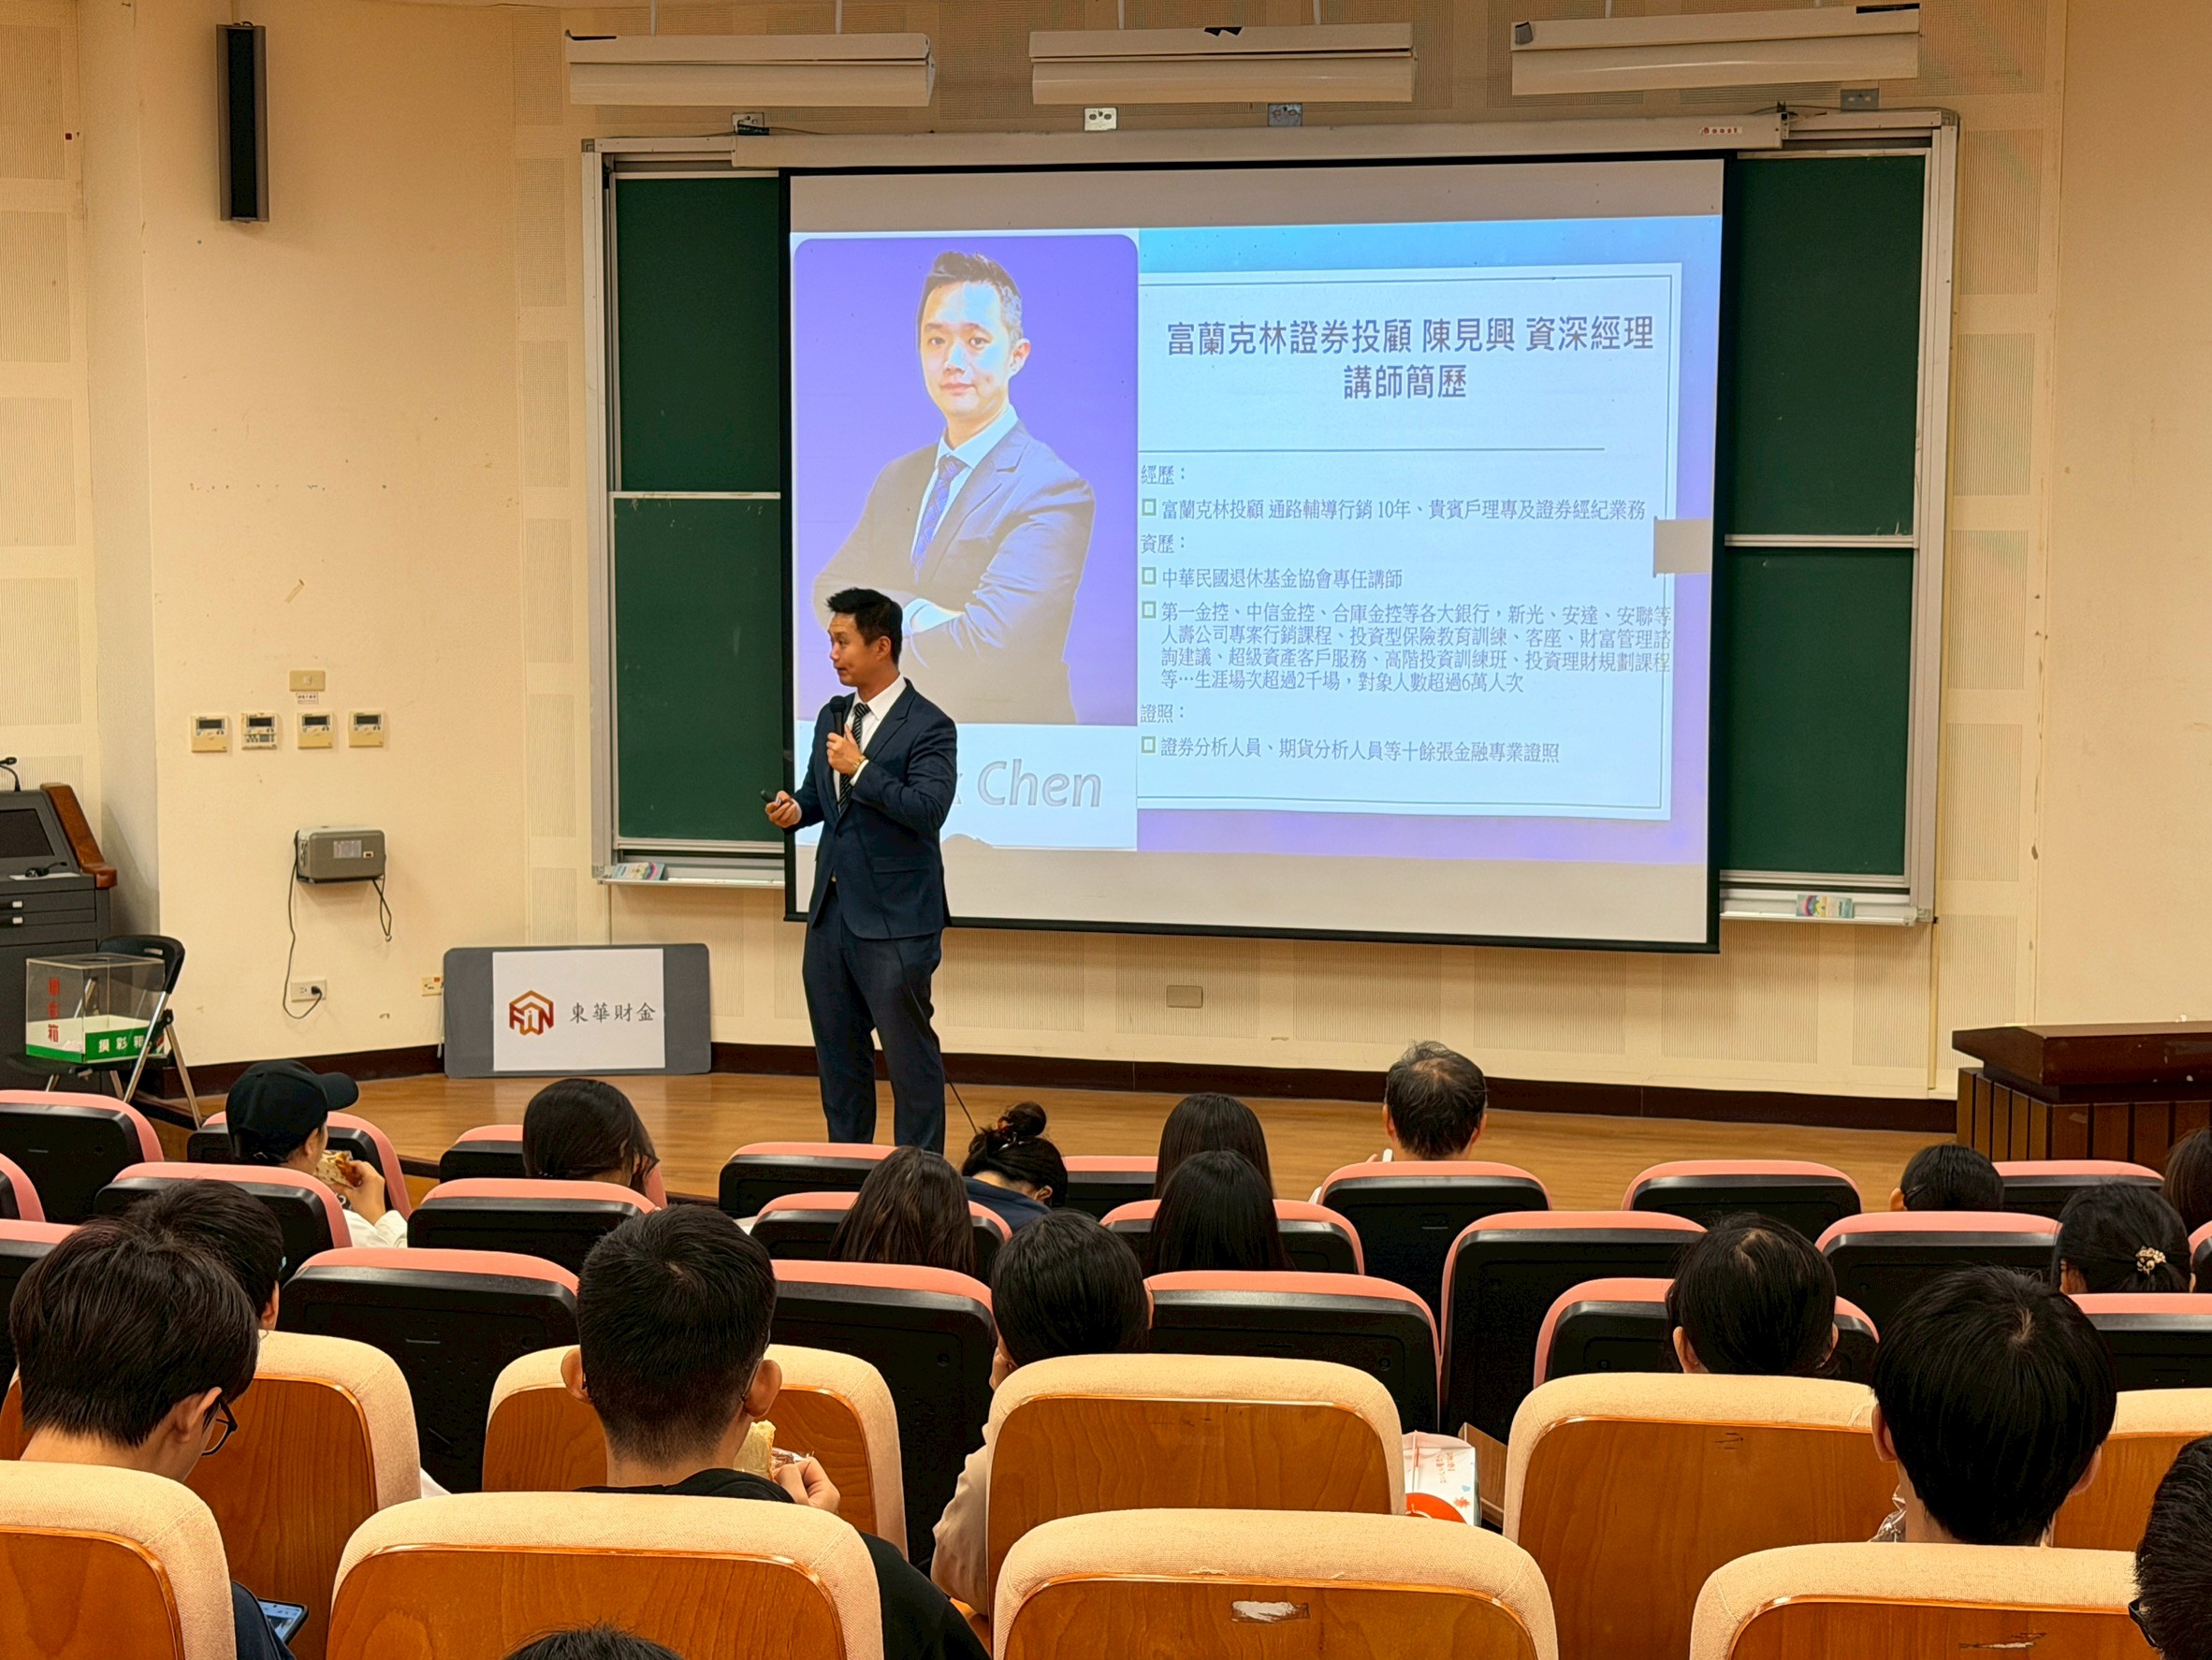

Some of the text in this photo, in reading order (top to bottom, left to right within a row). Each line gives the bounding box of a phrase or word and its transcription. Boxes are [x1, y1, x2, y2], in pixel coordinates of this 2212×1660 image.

[1167, 315, 1653, 357] 富蘭克林證券投顧 陳見興 資深經理
[1344, 364, 1467, 400] 講師簡歷
[1162, 499, 1264, 520] 富蘭克林投顧
[1162, 567, 1403, 590] 中華民國退休基金協會專任講師
[1160, 737, 1560, 763] 證券分析人員、期貨分析人員等十餘張金融專業證照
[977, 758, 1102, 808] Chen
[569, 1001, 657, 1024] 東華財金
